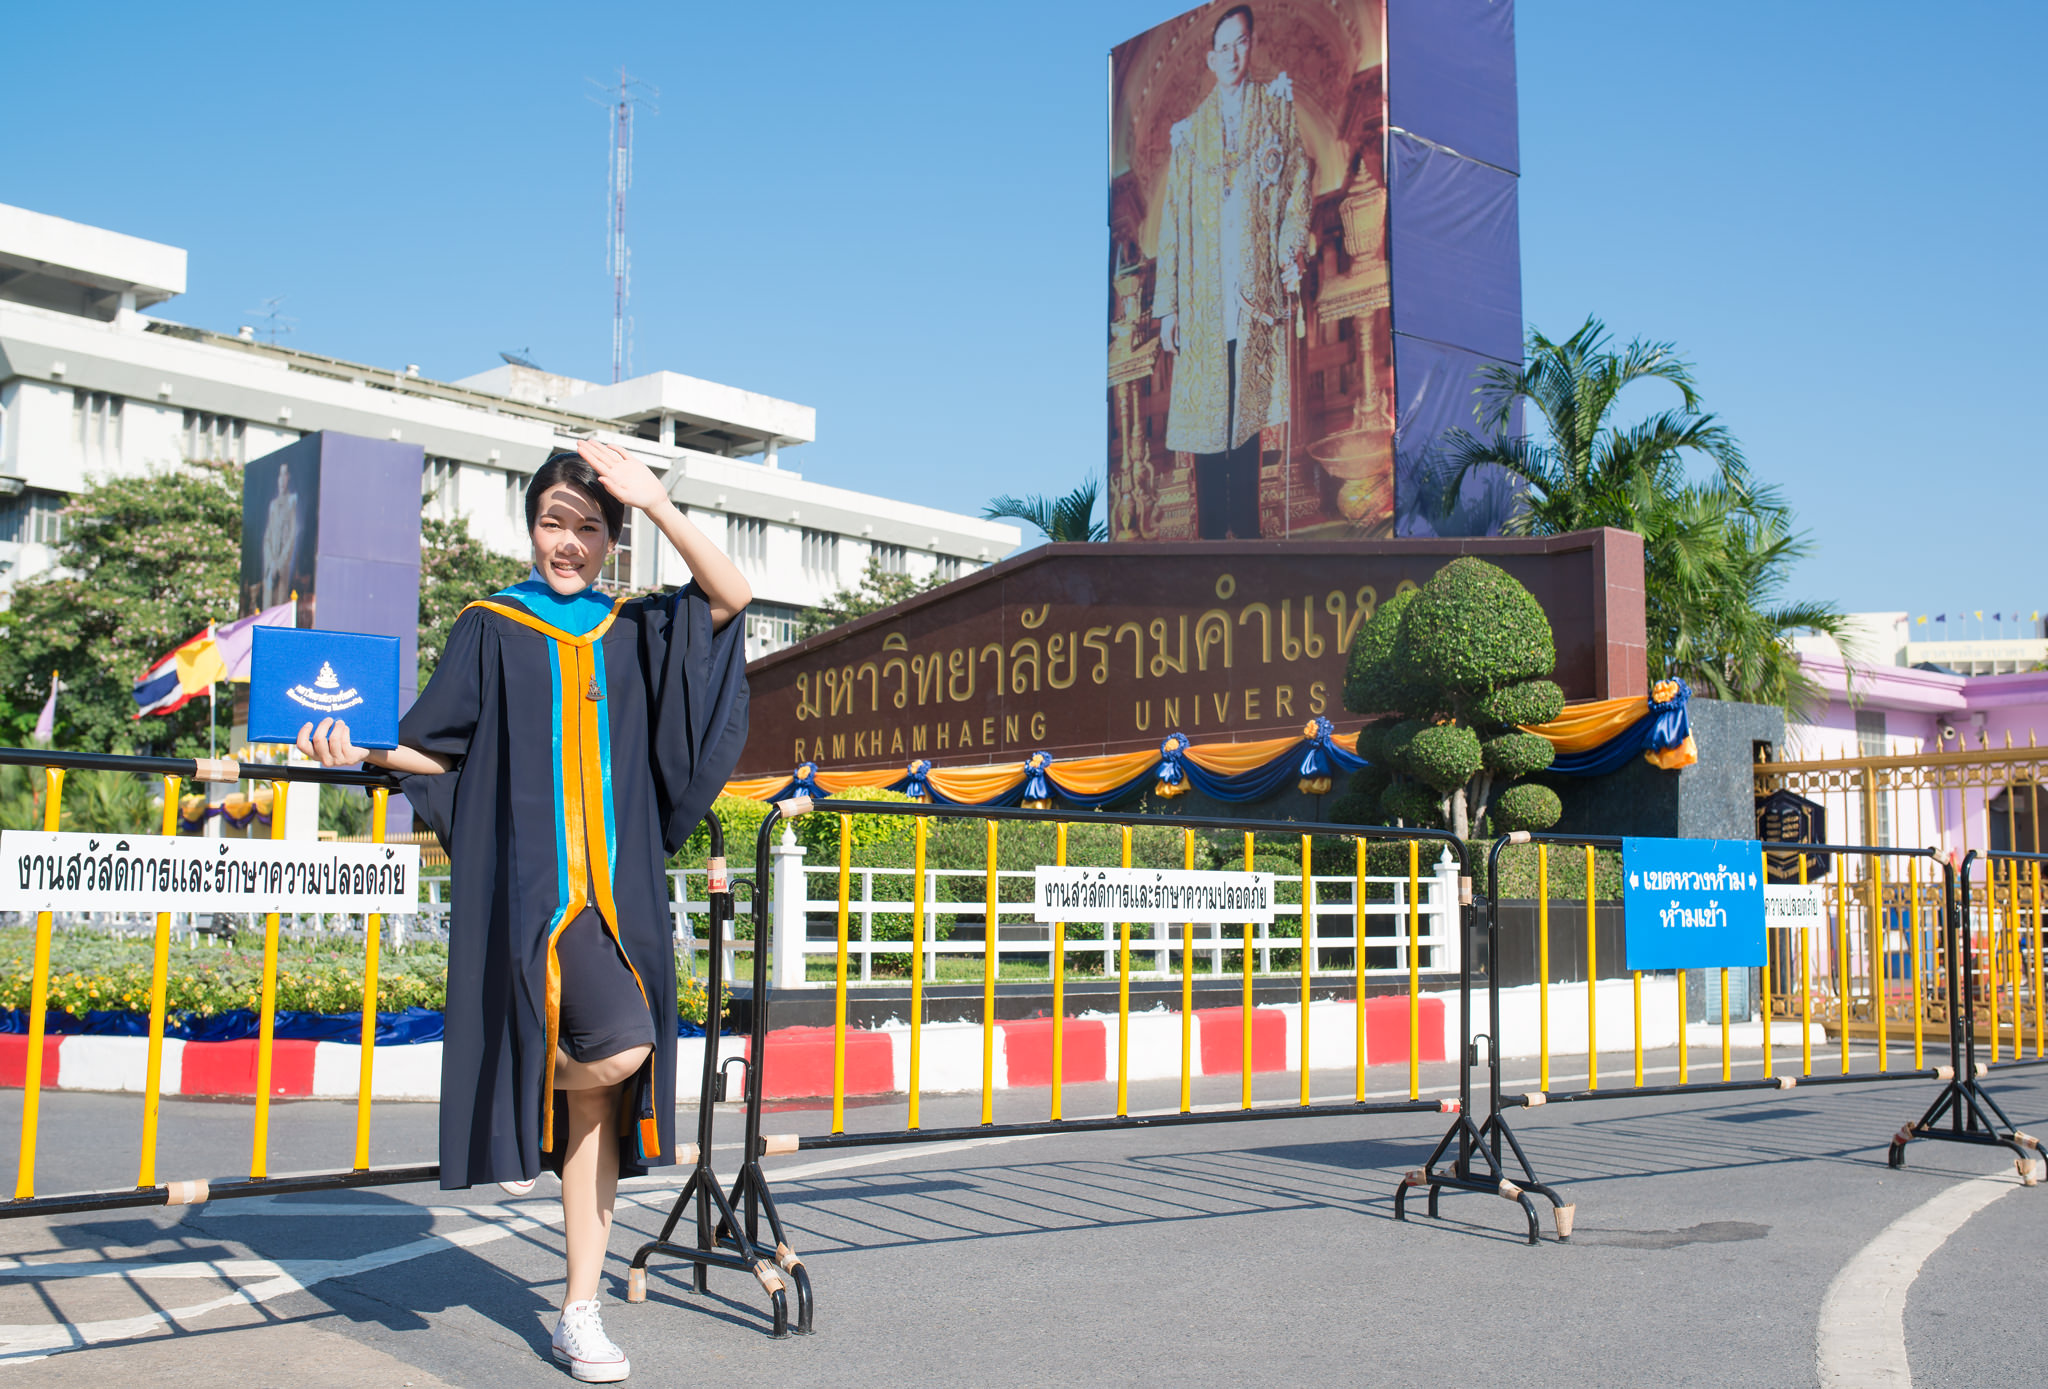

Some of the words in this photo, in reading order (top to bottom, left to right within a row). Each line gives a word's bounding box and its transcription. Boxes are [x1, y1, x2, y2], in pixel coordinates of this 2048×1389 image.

[796, 574, 1417, 721] มหาวิทยาลัยรามคำแห
[794, 711, 1047, 763] RAMKHAMHAENG
[1135, 679, 1348, 731] UNIVERS
[18, 839, 406, 895] งานสวัสดิการและรักษาความปลอดภัย
[1045, 871, 1267, 910] งานสวัสดิการและรักษาความปลอดภัย
[1643, 864, 1745, 891] เขตหวงห้าม
[1659, 899, 1727, 928] ห้ามเข้า
